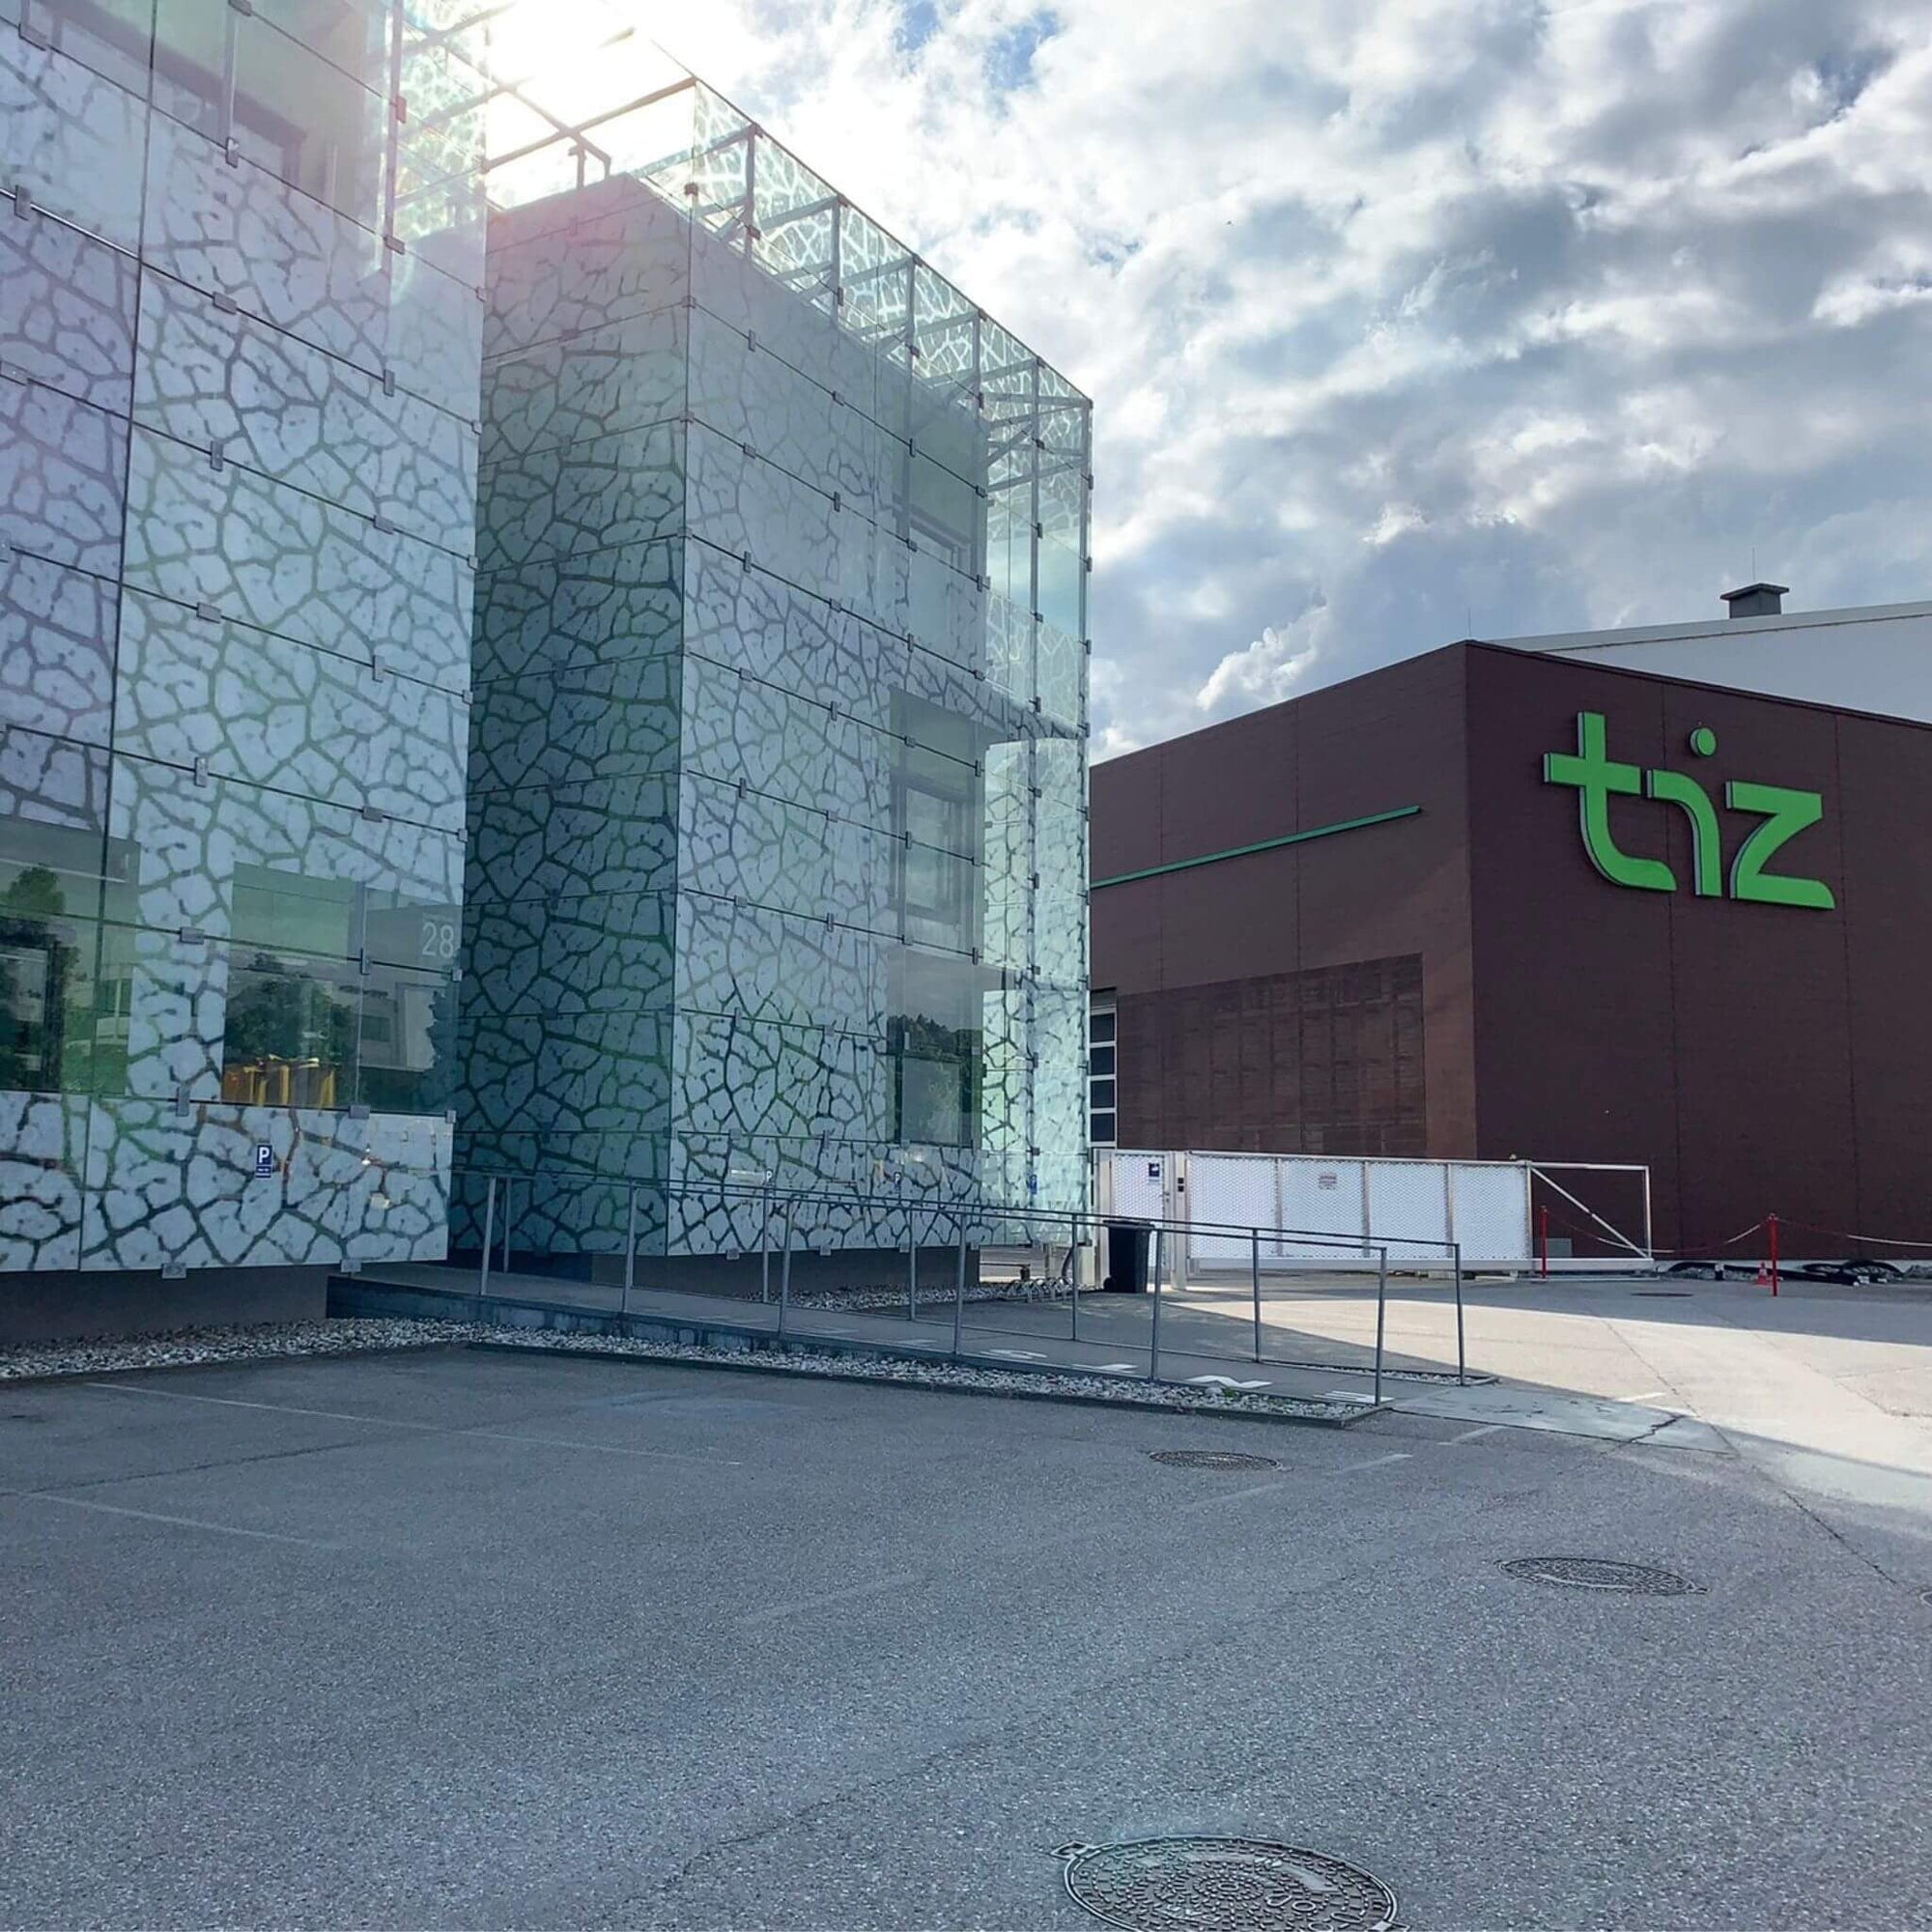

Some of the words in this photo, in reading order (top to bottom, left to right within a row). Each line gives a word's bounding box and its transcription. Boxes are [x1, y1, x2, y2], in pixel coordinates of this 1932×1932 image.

[1544, 711, 1835, 909] tiz
[422, 921, 454, 958] 28
[259, 1147, 270, 1163] P
